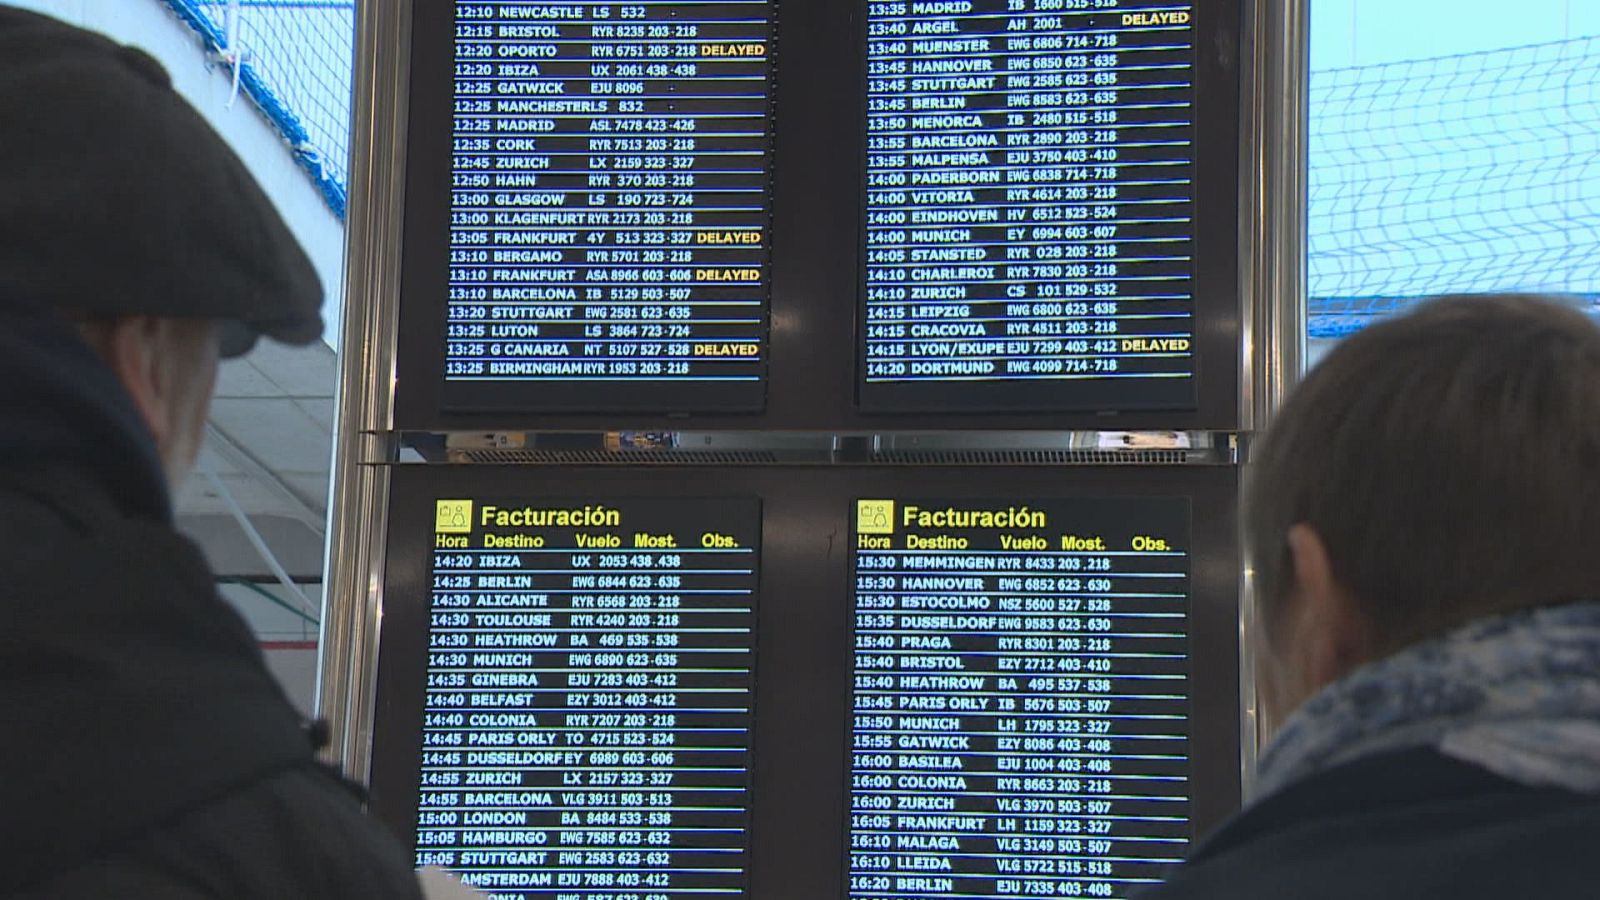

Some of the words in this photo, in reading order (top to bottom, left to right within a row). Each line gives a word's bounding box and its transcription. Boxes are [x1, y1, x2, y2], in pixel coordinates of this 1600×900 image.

[456, 7, 493, 18] 12:10
[499, 7, 583, 18] NEWCASTLE
[869, 6, 906, 16] 13:35
[912, 3, 972, 15] MADRID
[869, 24, 906, 35] 13:40
[912, 22, 958, 33] ARGEL
[1121, 13, 1190, 25] DELAYED
[499, 26, 559, 37] BRISTOL
[455, 45, 492, 56] 12:20
[498, 45, 557, 56] OPORTO
[701, 44, 765, 56] DELAYED
[869, 43, 906, 54] 13:40
[912, 40, 990, 53] MUENSTER
[455, 64, 492, 75] 12:20
[498, 64, 539, 75] IBIZA
[912, 59, 992, 72] HANNOVER
[497, 83, 564, 93] GATWICK
[912, 77, 997, 90] STUTTGART
[868, 99, 906, 110] 13:45
[912, 97, 966, 109] BERLIN
[497, 120, 555, 131] MADRID
[868, 118, 906, 129] 13:50
[912, 116, 982, 128] MENORCA
[454, 139, 490, 150] 12:35
[496, 139, 535, 150] CORK
[912, 135, 998, 147] BARCELONA
[453, 157, 490, 168] 12:45
[495, 157, 549, 168] ZURICH
[912, 153, 989, 166] MALPENSA
[453, 176, 490, 186] 12:50
[496, 176, 536, 186] HAHN
[868, 175, 906, 186] 14:00
[912, 172, 1000, 185] PADERBORN
[452, 195, 489, 205] 13:00
[494, 195, 566, 205] GLASGOW
[868, 194, 906, 204] 14:00
[911, 191, 974, 203] VITORIA
[452, 213, 489, 224] 13:00
[868, 213, 906, 224] 14:00
[912, 210, 998, 223] EINDHOVEN
[451, 232, 488, 243] 13:05
[494, 232, 577, 243] FRANKFURT
[697, 231, 761, 243] DELAYED
[868, 232, 906, 243] 14:00
[912, 230, 970, 242] MUNICH
[451, 251, 488, 262] 13:10
[494, 251, 563, 262] BERGAMO
[868, 251, 906, 262] 14:05
[911, 248, 986, 261] STANSTED
[450, 270, 487, 280] 13:10
[493, 270, 576, 280] FRANKFURT
[696, 269, 760, 280] DELAYED
[868, 270, 906, 281] 14:10
[911, 267, 994, 280] CHARLEROI
[449, 288, 486, 299] 13:10
[492, 288, 576, 299] BARCELONA
[868, 289, 906, 300] 14:10
[911, 287, 966, 299] ZURICH
[491, 307, 574, 318] STUTTGART
[912, 306, 970, 318] LEIPZIG
[448, 325, 485, 336] 13:25
[491, 325, 538, 336] LUTON
[868, 326, 905, 337] 14:15
[911, 324, 986, 336] CRACOVIA
[448, 344, 484, 355] 13:25
[490, 344, 500, 355] G
[504, 344, 569, 355] CANARIA
[694, 343, 758, 355] DELAYED
[1121, 337, 1190, 349] DELAYED
[868, 364, 906, 375] 14:20
[911, 362, 995, 374] DORTMUND
[482, 506, 620, 527] Facturación
[904, 506, 1046, 527] Facturación
[435, 536, 469, 549] Hora
[484, 535, 544, 549] Destino
[576, 535, 621, 549] Vuelo
[635, 535, 677, 549] Most.
[702, 536, 739, 549] Obs.
[858, 535, 891, 549] Hora
[906, 536, 968, 549] Destino
[1001, 536, 1047, 550] Vuelo
[1062, 537, 1106, 550] Most.
[1131, 538, 1170, 551] Obs.
[434, 556, 473, 567] 14:20
[479, 555, 521, 567] IBIZA
[902, 557, 995, 568] MEMMINGEN
[478, 576, 532, 587] BERLIN
[857, 577, 896, 588] 15:30
[902, 577, 984, 589] HANNOVER
[433, 595, 470, 606] 14:30
[476, 595, 548, 606] ALICANTE
[856, 596, 896, 607] 15:30
[901, 596, 990, 608] ESTOCOLMO
[431, 614, 470, 626] 14:30
[475, 615, 551, 626] TOULOUSE
[430, 634, 468, 646] 14:30
[475, 634, 558, 646] HEATHROW
[856, 636, 895, 647] 15:40
[901, 636, 952, 648] PRAGA
[429, 654, 467, 665] 14:30
[473, 654, 532, 666] MUNICH
[855, 656, 894, 667] 15:40
[900, 656, 965, 668] BRISTOL
[428, 674, 466, 685] 14:35
[472, 674, 538, 685] GINEBRA
[855, 676, 894, 687] 15:40
[900, 676, 985, 688] HEATHROW
[426, 694, 465, 705] 14:40
[471, 694, 534, 705] BELFAST
[854, 696, 893, 707] 15:45
[900, 697, 946, 708] PARIS
[949, 697, 988, 708] ORLY
[425, 714, 464, 725] 14:40
[469, 714, 536, 725] COLONIA
[899, 717, 960, 729] MUNICH
[424, 733, 462, 744] 14:45
[468, 733, 514, 744] PARIS
[517, 733, 556, 744] ORLY
[898, 736, 969, 748] GATWICK
[423, 753, 461, 764] 14:45
[853, 755, 892, 767] 16:00
[898, 756, 963, 768] BASILEA
[421, 773, 460, 784] 14:55
[466, 773, 522, 784] ZURICH
[852, 776, 892, 787] 16:00
[898, 776, 967, 788] COLONIA
[464, 793, 553, 804] BARCELONA
[852, 796, 892, 807] 16:00
[897, 797, 954, 808] ZURICH
[418, 813, 457, 824] 15:00
[464, 813, 526, 824] LONDON
[852, 816, 891, 827] 16:05
[898, 817, 986, 829] FRANKFURT
[417, 832, 456, 844] 15:05
[462, 832, 547, 843] HAMBURGO
[852, 836, 891, 847] 16:10
[897, 837, 960, 848] MALAGA
[460, 852, 547, 864] STUTTGART
[851, 856, 890, 868] 16:10
[897, 857, 952, 869] LLEIDA
[461, 873, 552, 884] AMSTERDAM
[850, 876, 890, 888] 16:20
[896, 877, 953, 889] BERLIN
